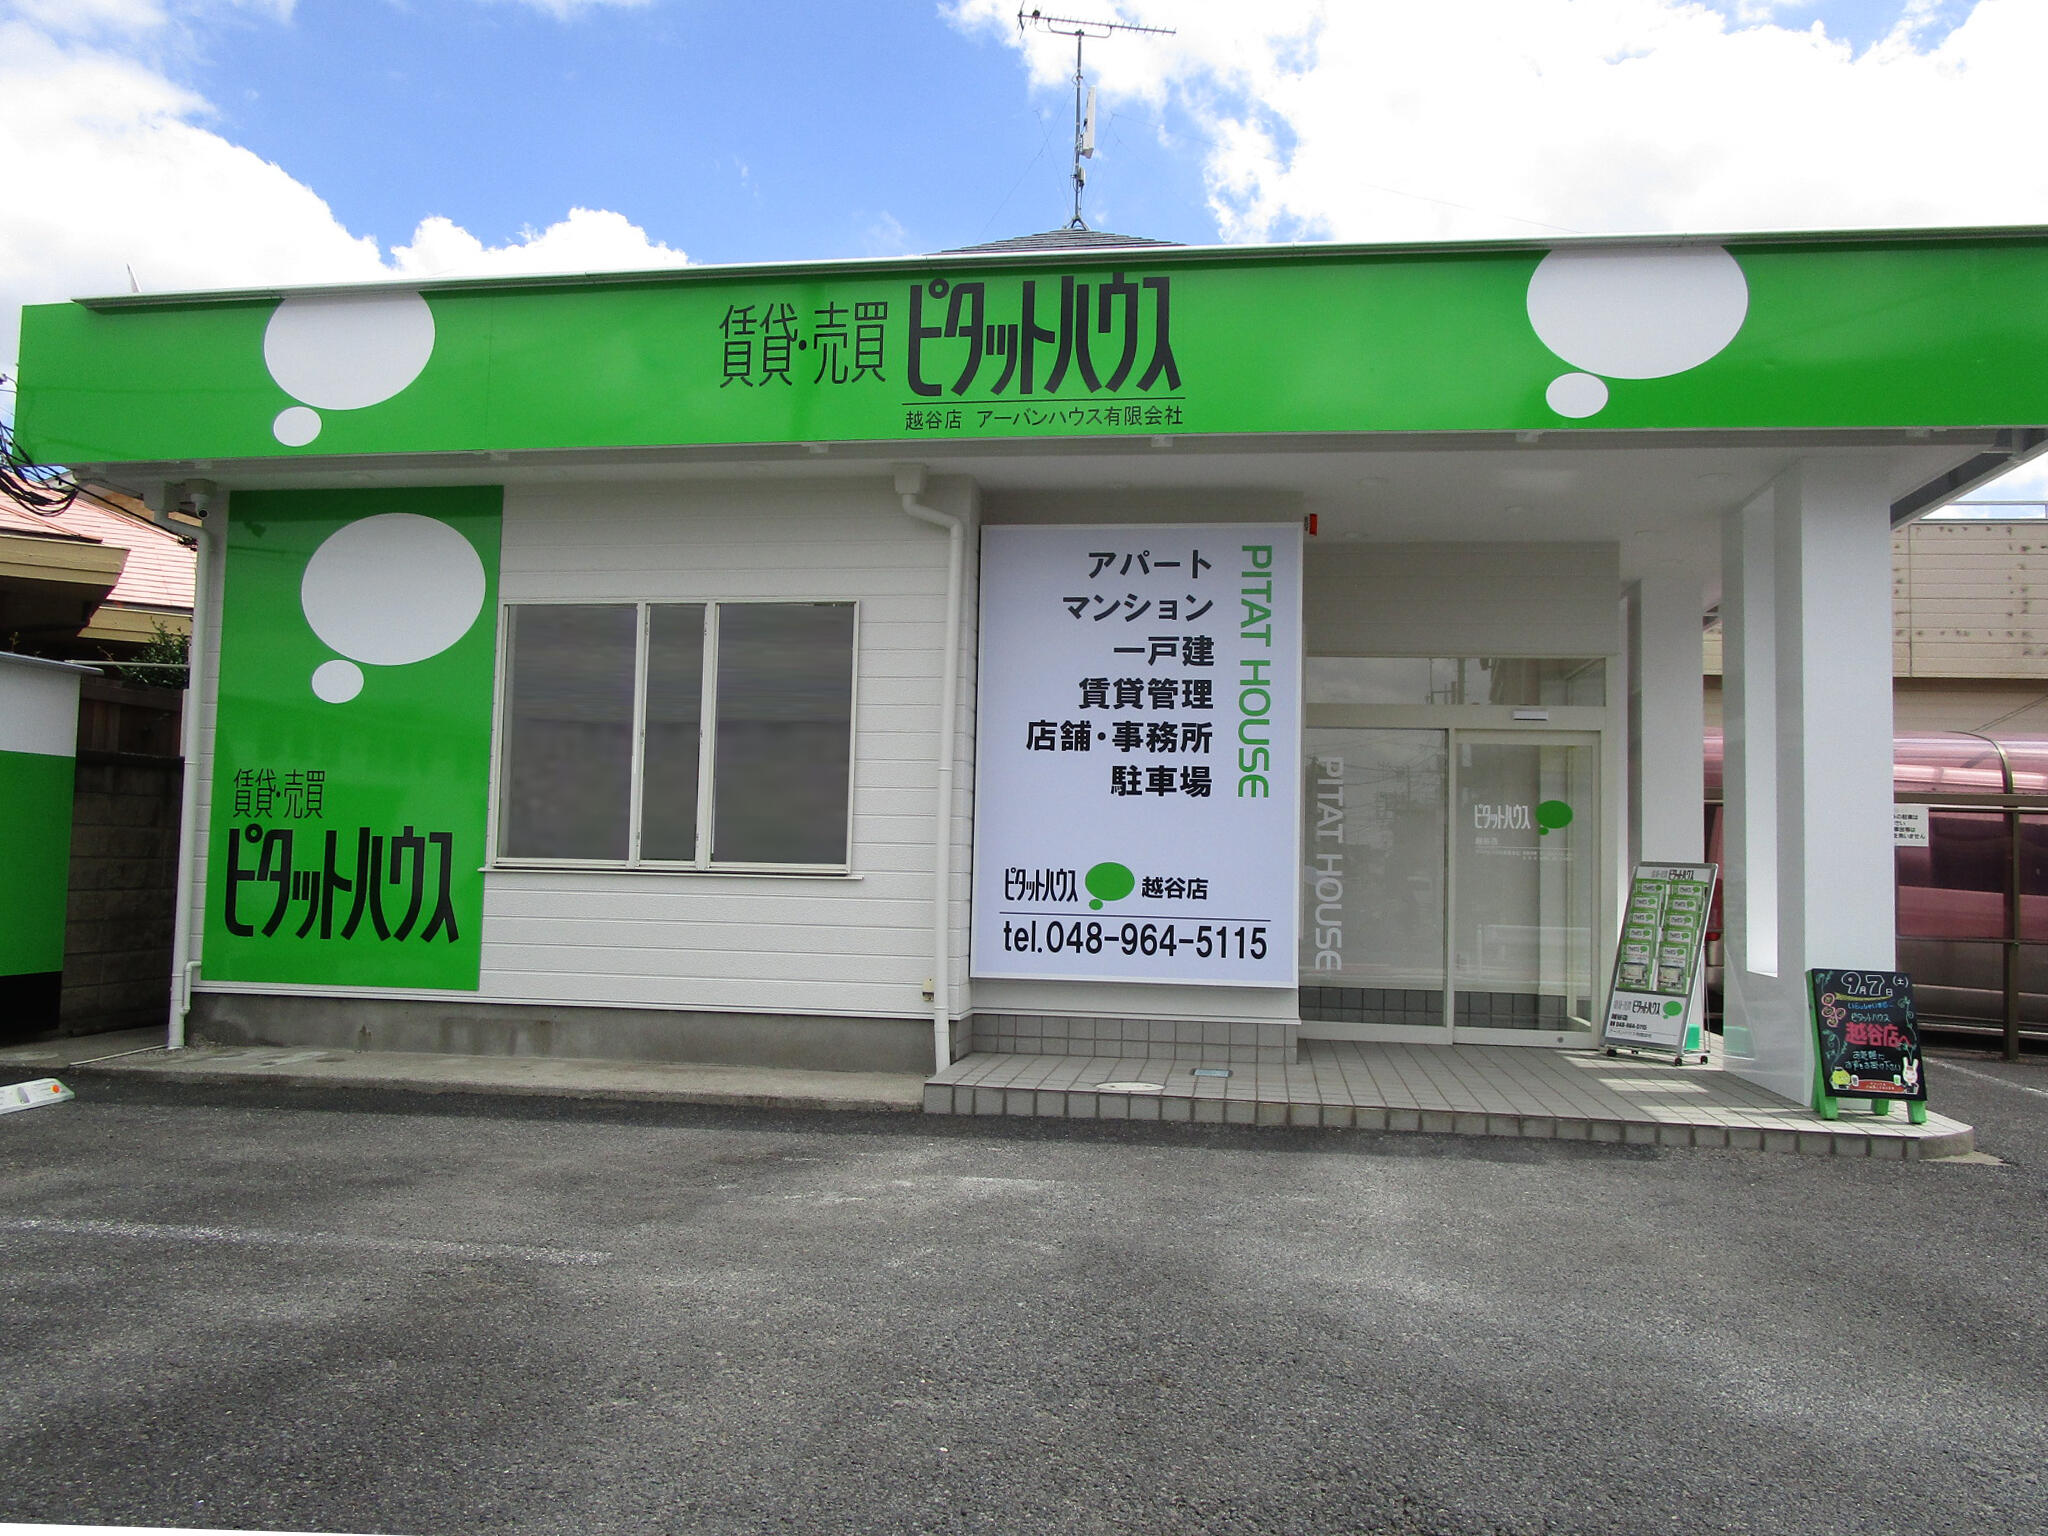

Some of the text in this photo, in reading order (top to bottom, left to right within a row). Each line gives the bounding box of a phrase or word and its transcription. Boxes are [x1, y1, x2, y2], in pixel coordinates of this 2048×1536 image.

[719, 272, 1182, 397] 賃貸・売買 ピタットハウス
[905, 405, 1184, 430] 越谷店 アーバンハウス有限会社
[1088, 549, 1212, 579] アパート
[1063, 593, 1214, 622] マンション
[1113, 634, 1215, 667] 一戸建
[1238, 545, 1273, 798] PITAT HOUSE
[1078, 677, 1214, 710] 賃貸管理
[1026, 719, 1213, 754] 店舗・事務所
[233, 768, 326, 819] 賃貸・売買
[1110, 764, 1213, 798] 駐車場
[1474, 804, 1531, 829] ピタットハウス
[1314, 756, 1344, 970] PITAT HOUSE
[225, 823, 459, 943] ピタットハウス
[1005, 868, 1209, 903] ピタットハウス 越谷店
[1003, 919, 1268, 960] tel.048-964-5115
